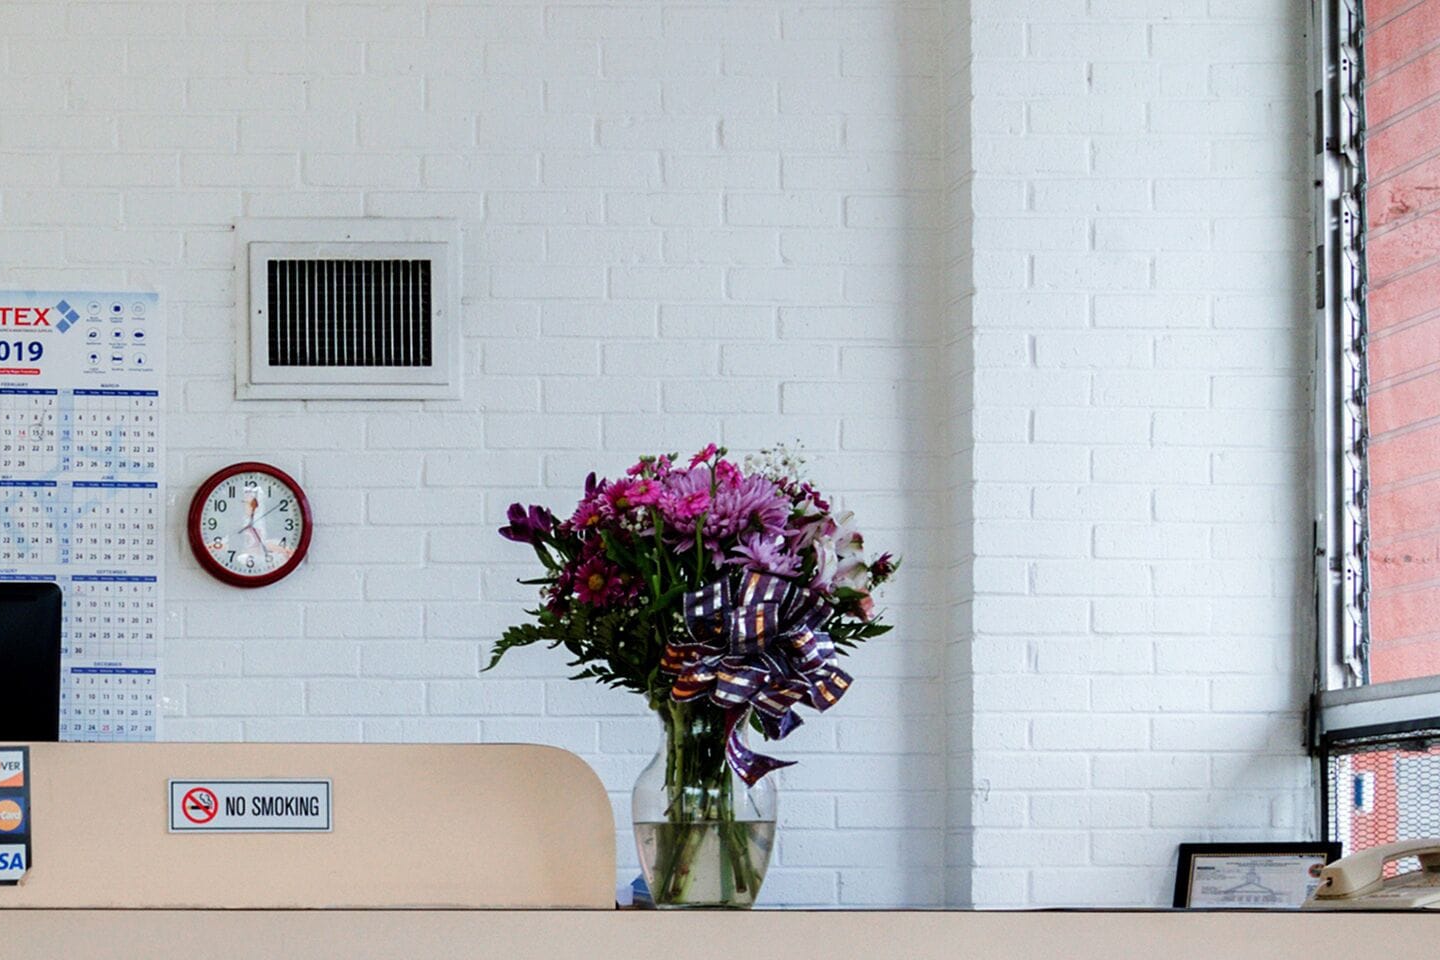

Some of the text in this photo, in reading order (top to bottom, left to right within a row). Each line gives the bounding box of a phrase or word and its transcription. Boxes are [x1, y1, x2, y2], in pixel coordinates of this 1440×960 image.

[228, 486, 235, 498] 11
[214, 500, 227, 512] 10
[280, 499, 288, 512] 2
[208, 518, 217, 530] 9
[284, 519, 294, 531] 3
[213, 537, 223, 549] 8
[279, 537, 287, 548] 4
[227, 550, 236, 562] 7
[246, 555, 255, 568] 6
[264, 551, 273, 562] 5
[226, 796, 320, 816] NO SMOKING
